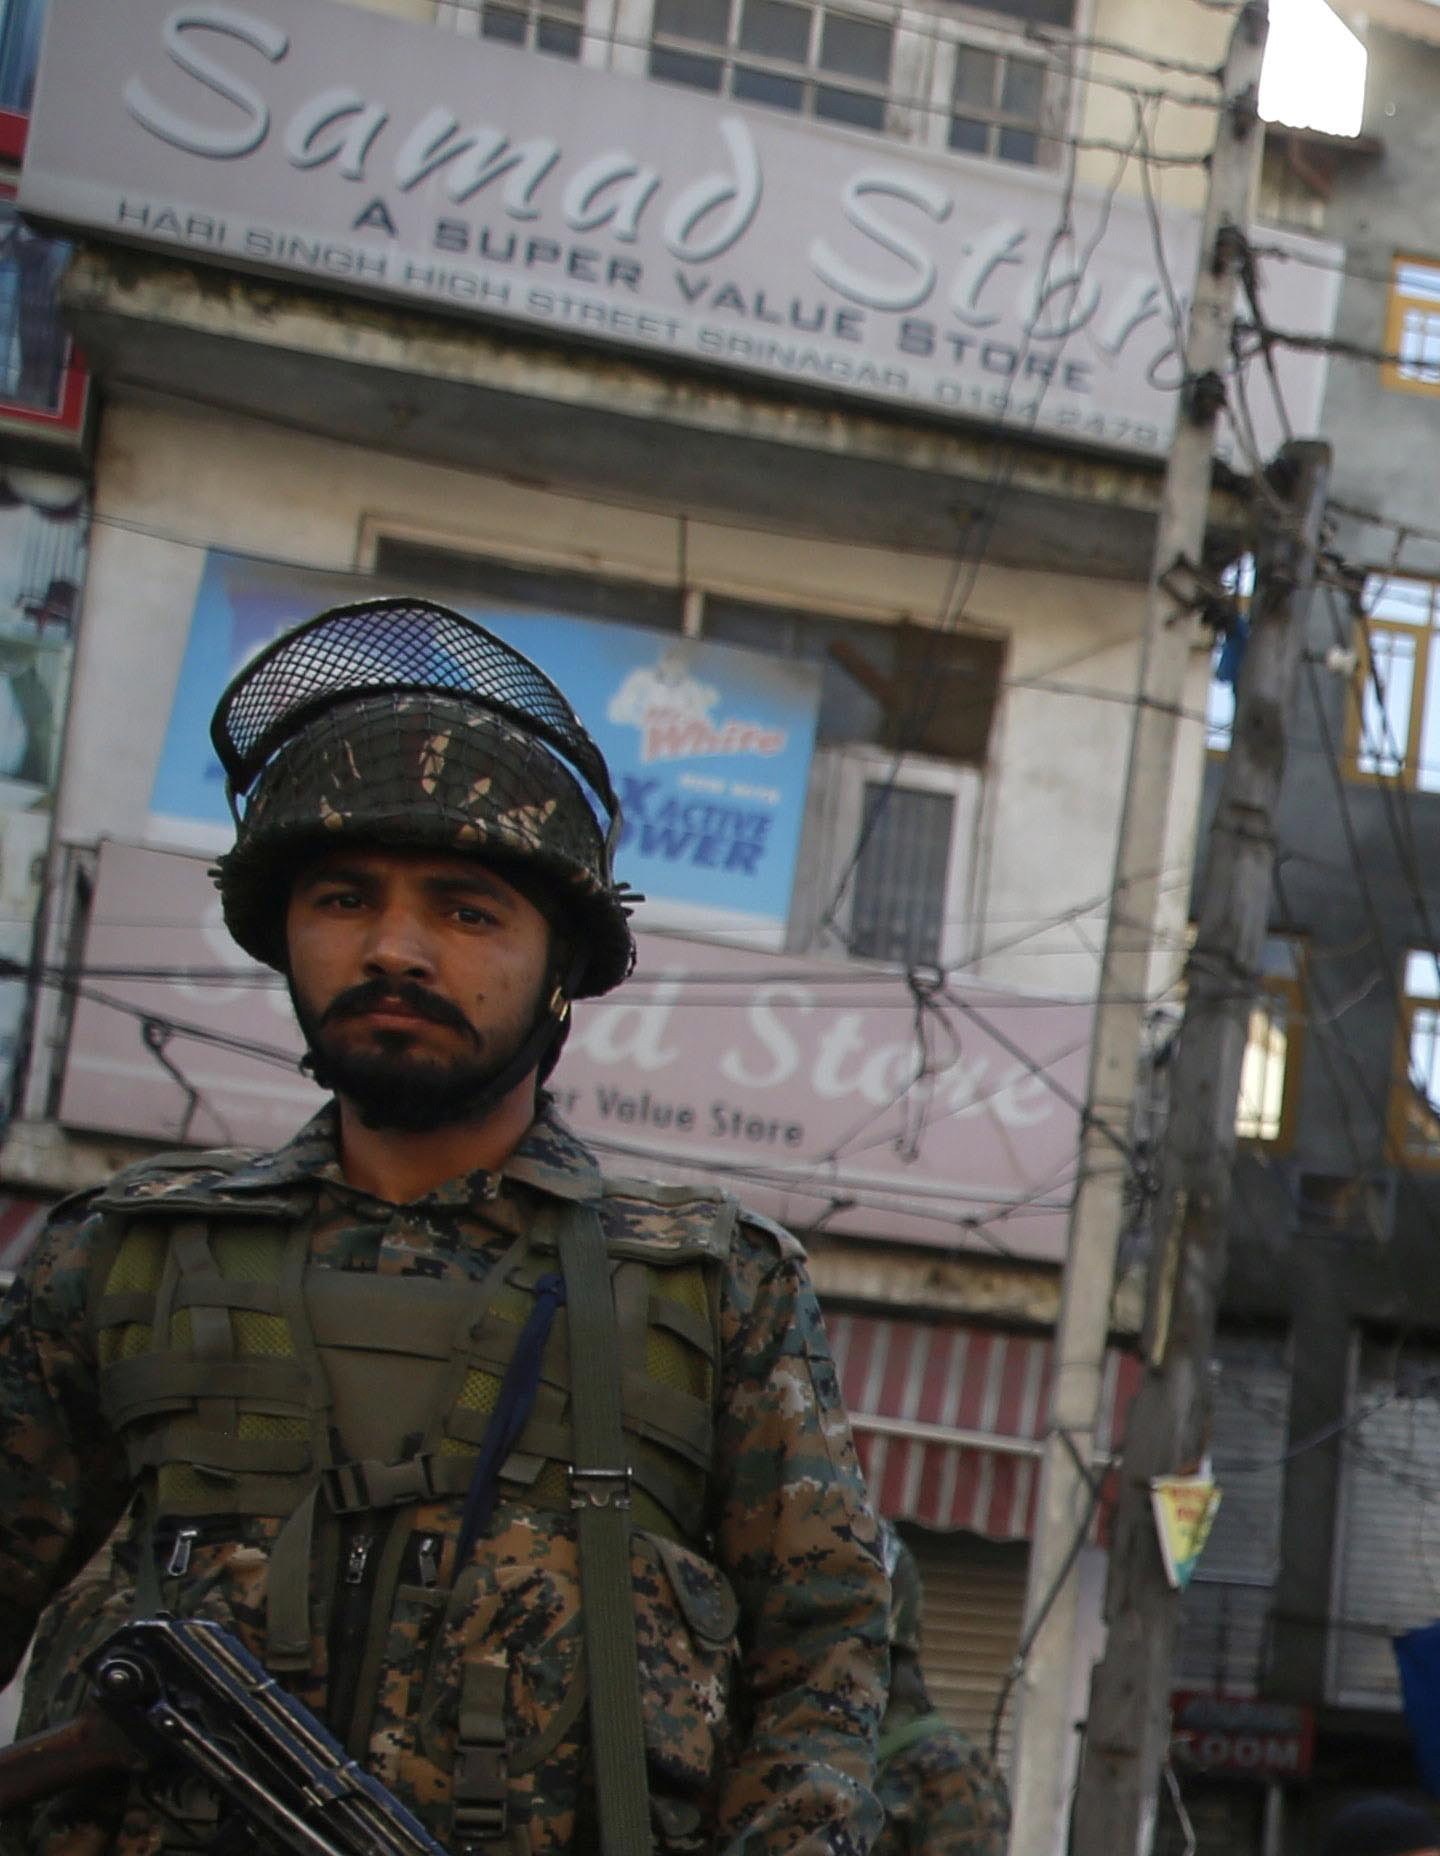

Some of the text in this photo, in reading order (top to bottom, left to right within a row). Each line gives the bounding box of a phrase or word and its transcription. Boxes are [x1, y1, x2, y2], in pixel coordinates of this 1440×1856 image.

[124, 8, 1250, 380] Samad Stor
[117, 199, 228, 245] HARI
[246, 229, 389, 277] SINGH
[403, 262, 510, 301] HIGH
[528, 286, 681, 341] STREET
[352, 197, 1093, 394] A SUPER VALUE STORE
[595, 1086, 695, 1132] Value
[708, 1104, 804, 1148] Store
[719, 978, 1053, 1129] Store
